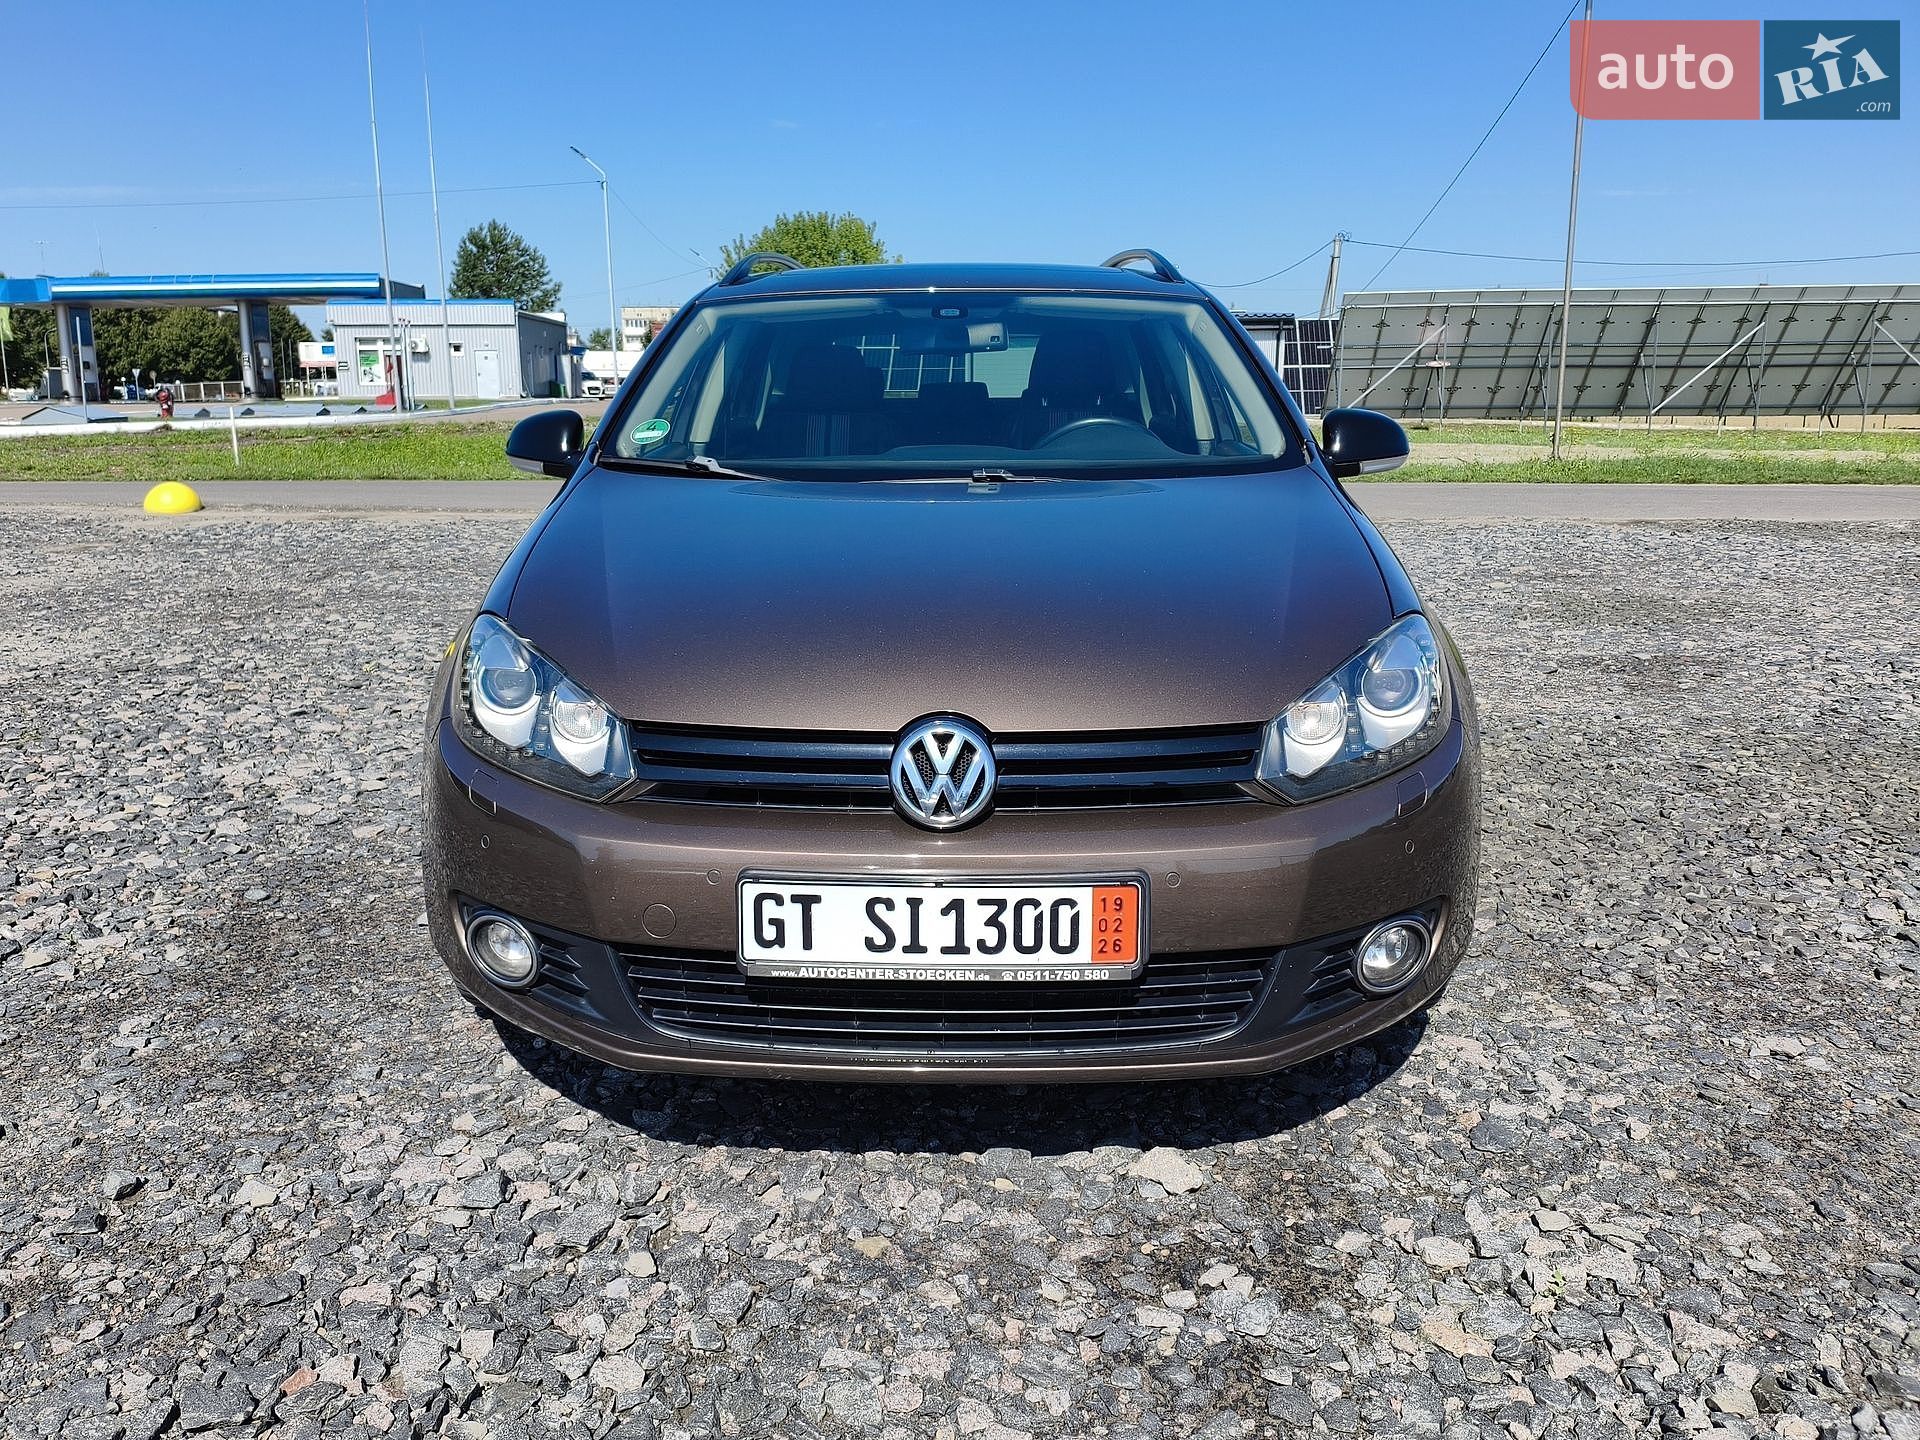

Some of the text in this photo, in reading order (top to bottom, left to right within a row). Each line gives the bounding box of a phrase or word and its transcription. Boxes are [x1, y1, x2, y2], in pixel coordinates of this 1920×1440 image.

[646, 421, 657, 431] 4
[1100, 896, 1124, 913] 19
[753, 892, 823, 951] GT
[1098, 917, 1123, 934] 02
[1097, 938, 1123, 954] 26
[771, 967, 1110, 982] www.AUTOCENTER-STOECKEN.de 0511-750 580
